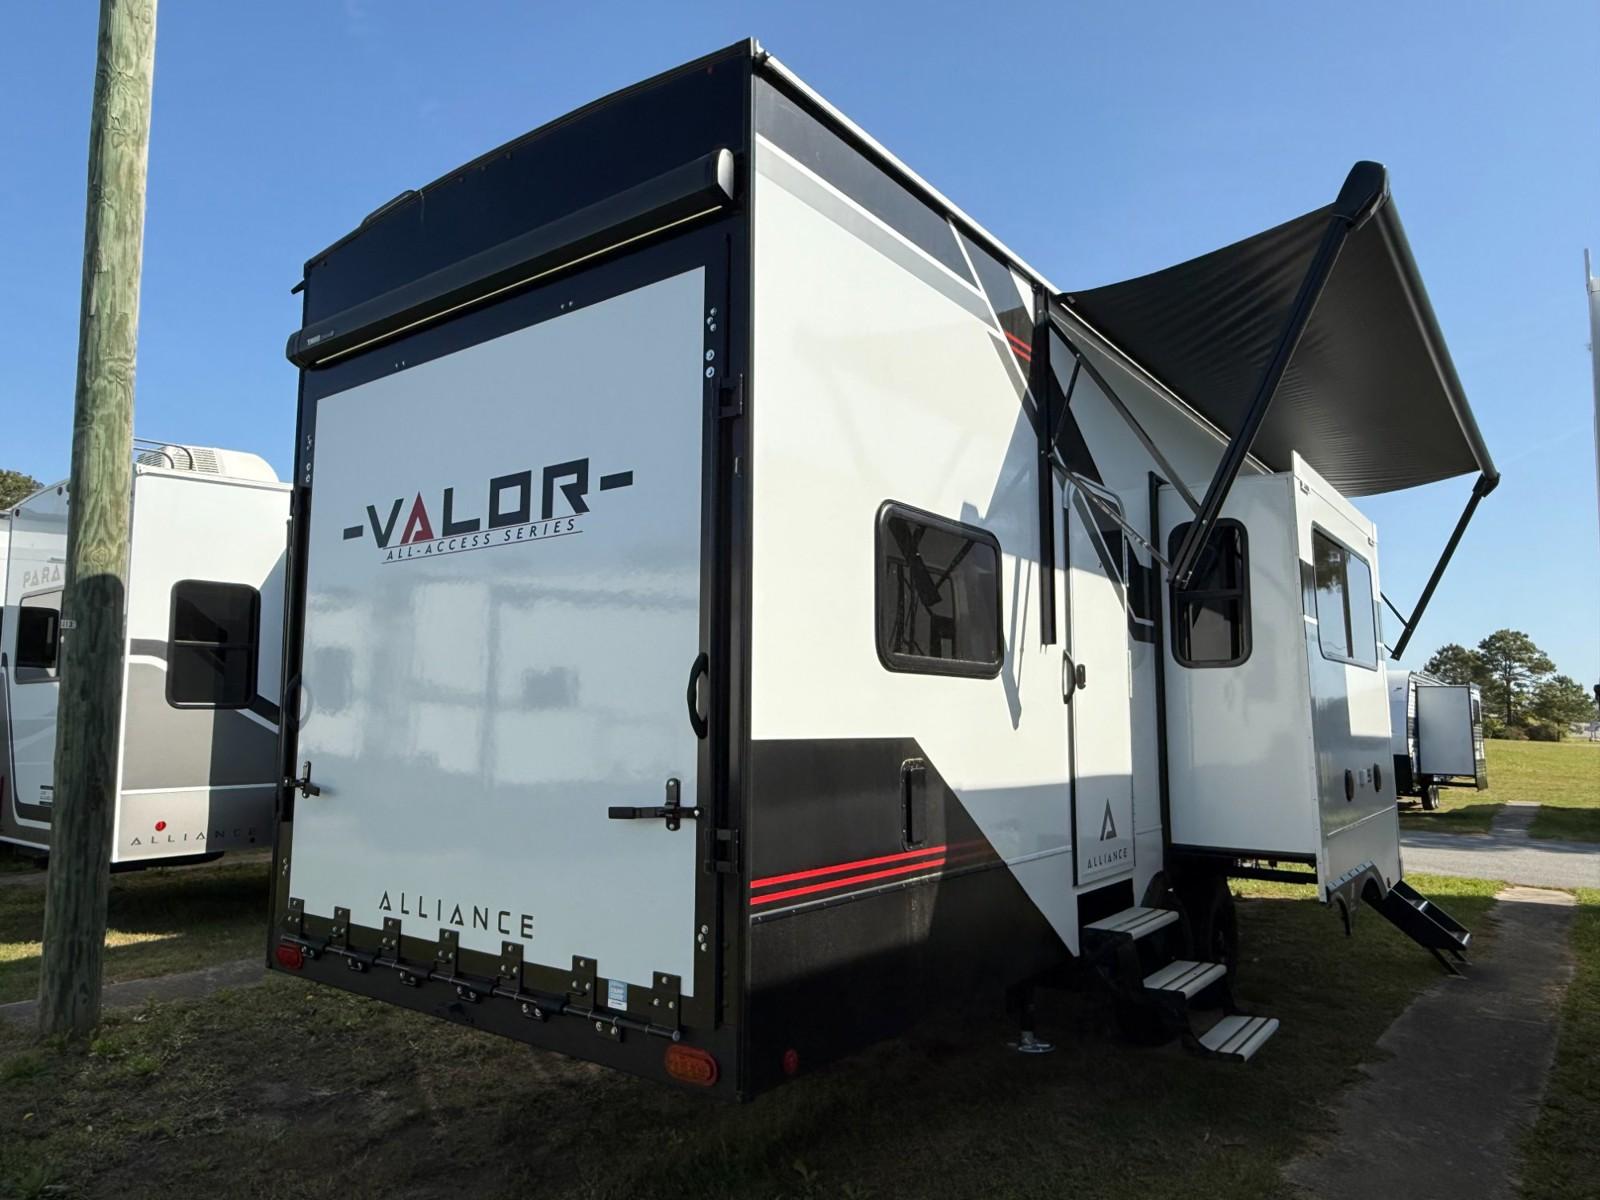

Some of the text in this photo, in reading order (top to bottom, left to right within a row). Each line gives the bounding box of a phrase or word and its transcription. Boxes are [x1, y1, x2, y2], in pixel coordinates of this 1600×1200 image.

[386, 518, 576, 561] ALL-ACCESS SERIES
[131, 827, 257, 846] ALLIANCE
[1086, 847, 1128, 869] ALLIANCE
[379, 890, 534, 939] ALLIANCE
